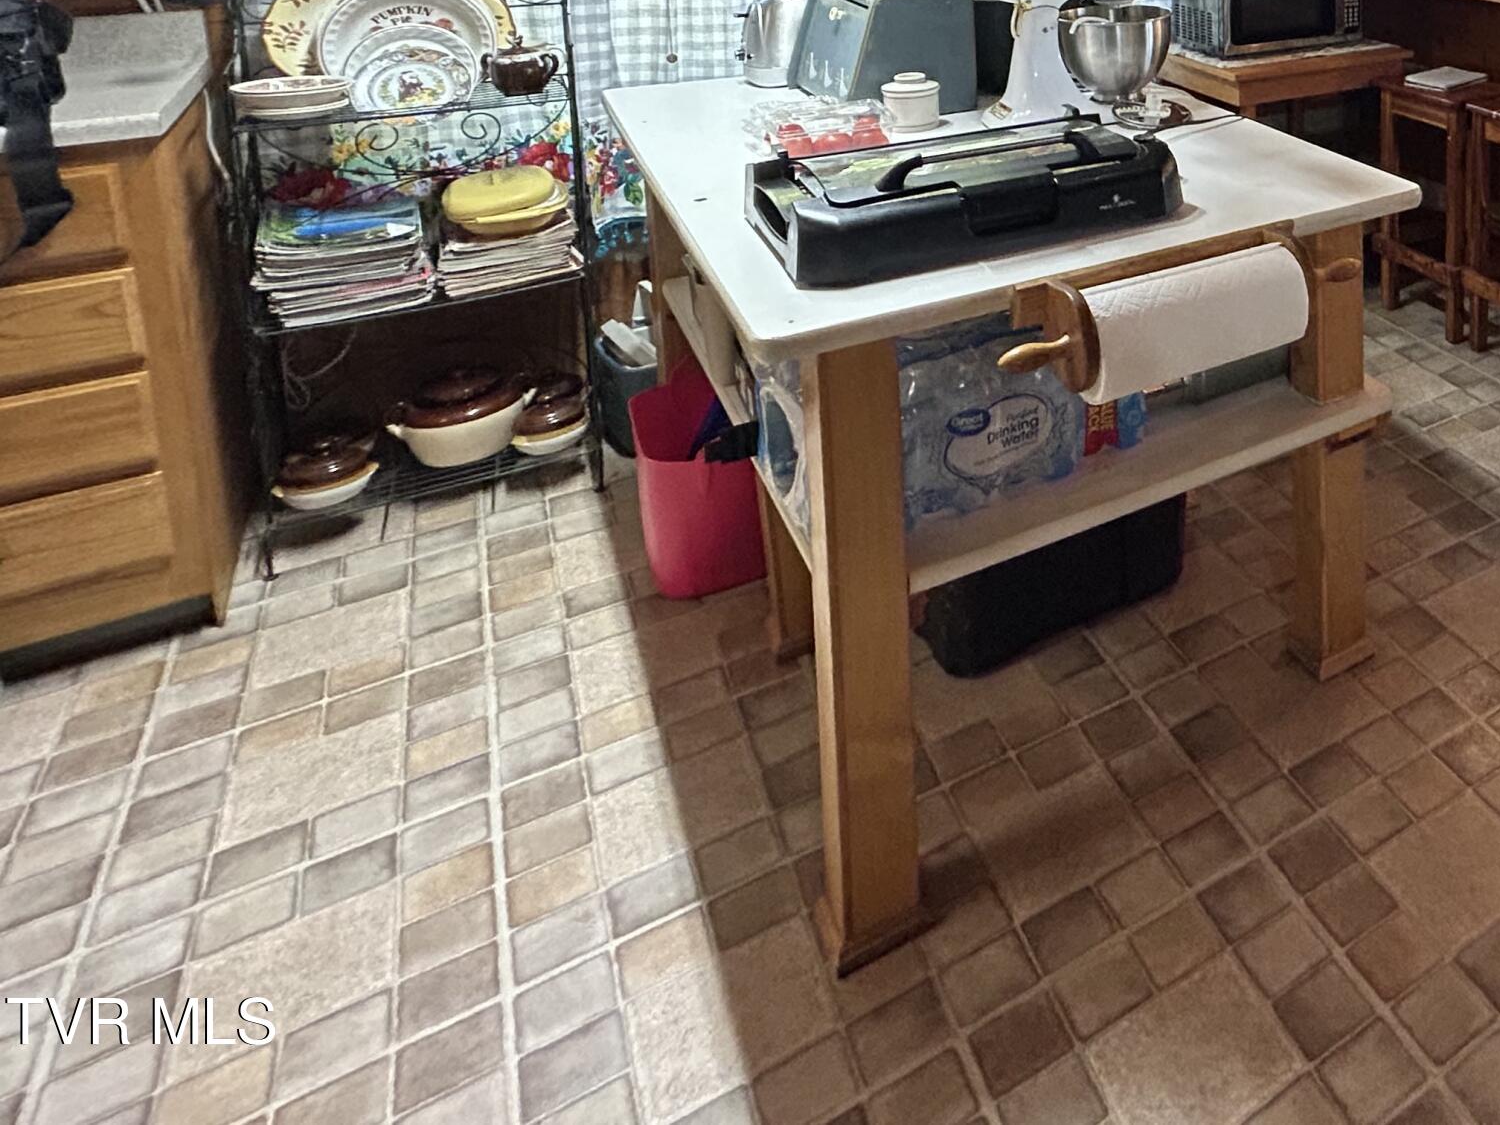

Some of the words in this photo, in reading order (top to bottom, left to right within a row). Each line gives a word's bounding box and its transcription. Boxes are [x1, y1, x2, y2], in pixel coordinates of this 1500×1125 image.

[370, 5, 433, 24] PUMPKIN
[987, 416, 1039, 445] Drinking
[1000, 427, 1040, 448] Water
